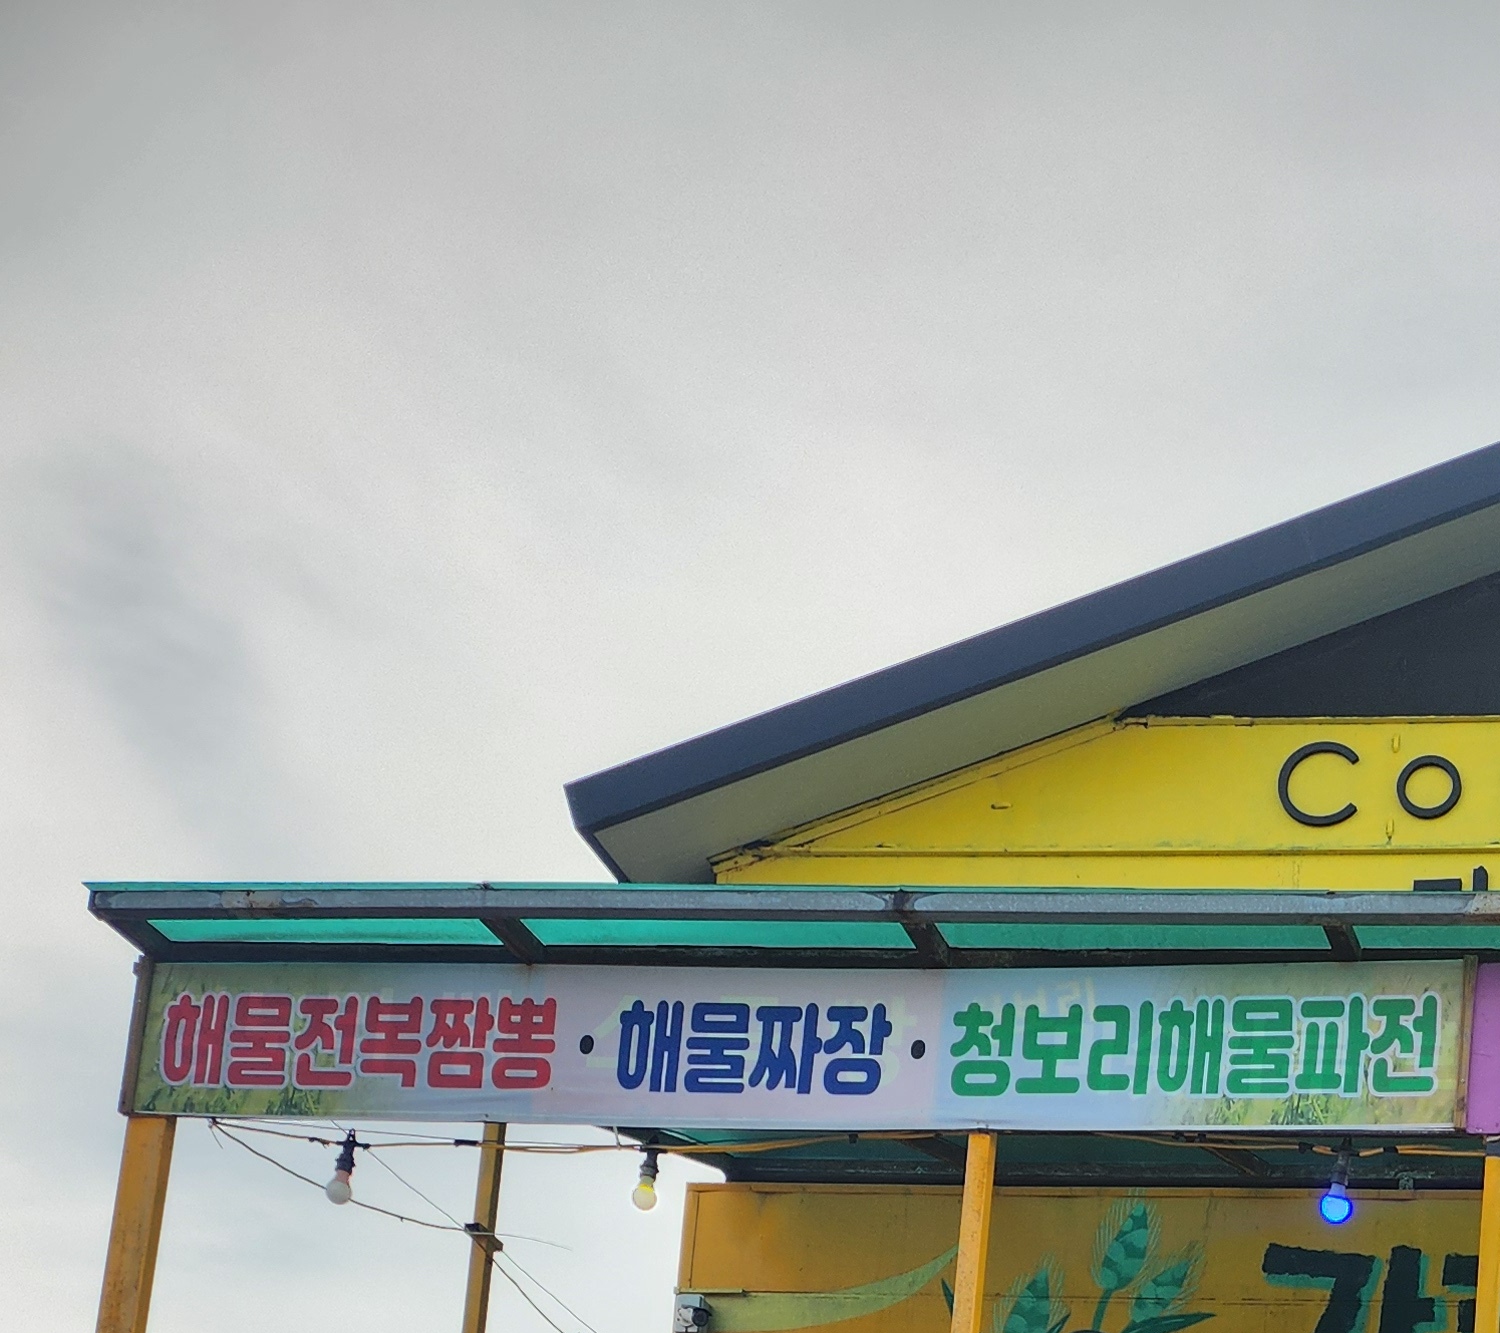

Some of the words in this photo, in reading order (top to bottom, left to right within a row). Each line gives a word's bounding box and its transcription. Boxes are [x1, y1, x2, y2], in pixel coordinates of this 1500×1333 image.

[159, 993, 558, 1091] 해물전복짬뽕
[616, 999, 893, 1096] 해물짜장
[950, 996, 1439, 1097] 청보리해물파전
